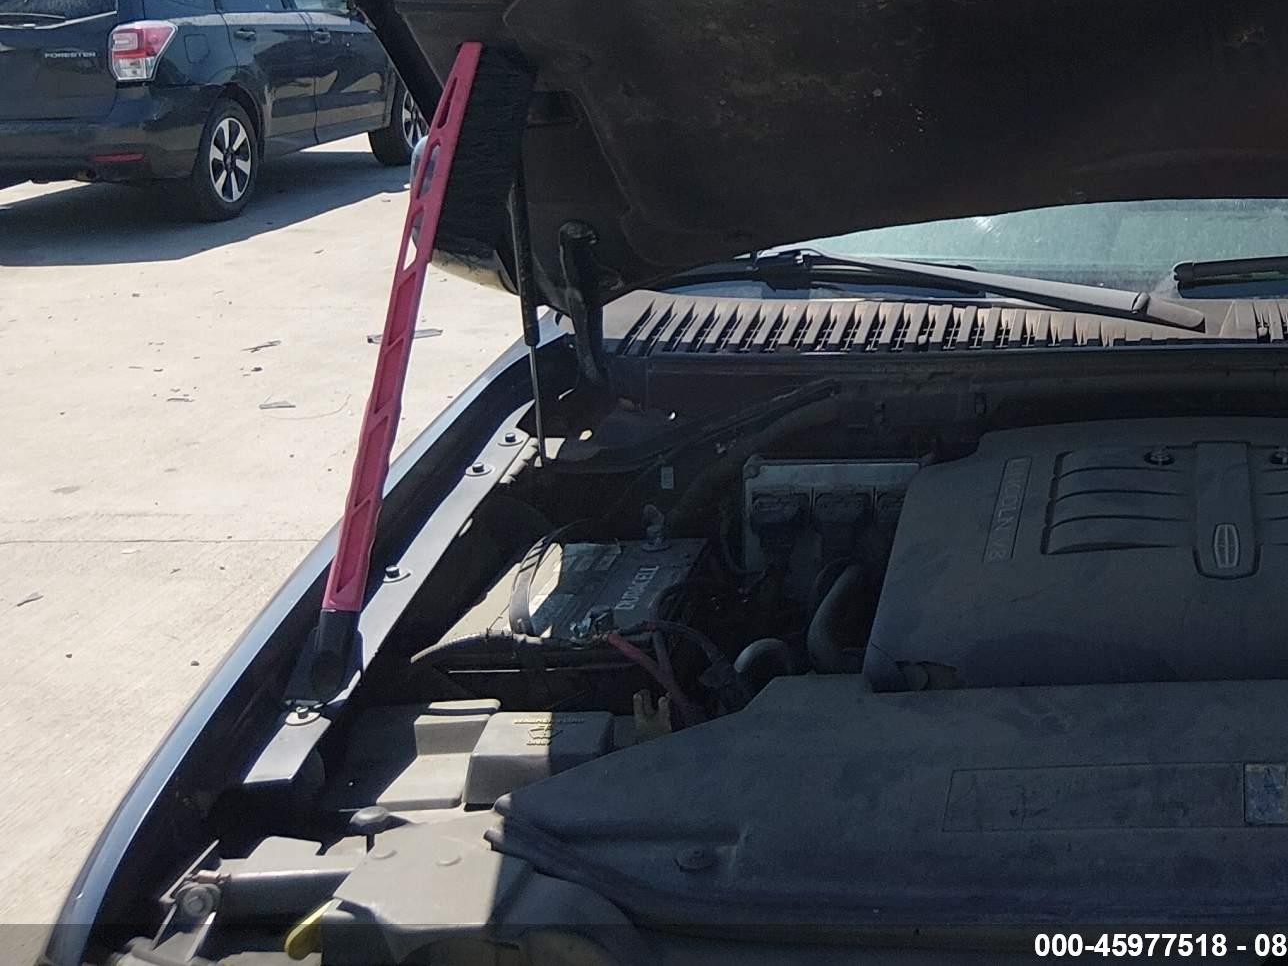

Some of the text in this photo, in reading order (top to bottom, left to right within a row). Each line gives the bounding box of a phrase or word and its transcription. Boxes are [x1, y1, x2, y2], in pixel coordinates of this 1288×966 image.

[44, 51, 97, 59] FORESTER
[992, 458, 1026, 531] LINCOLN
[615, 564, 660, 611] DURACELL
